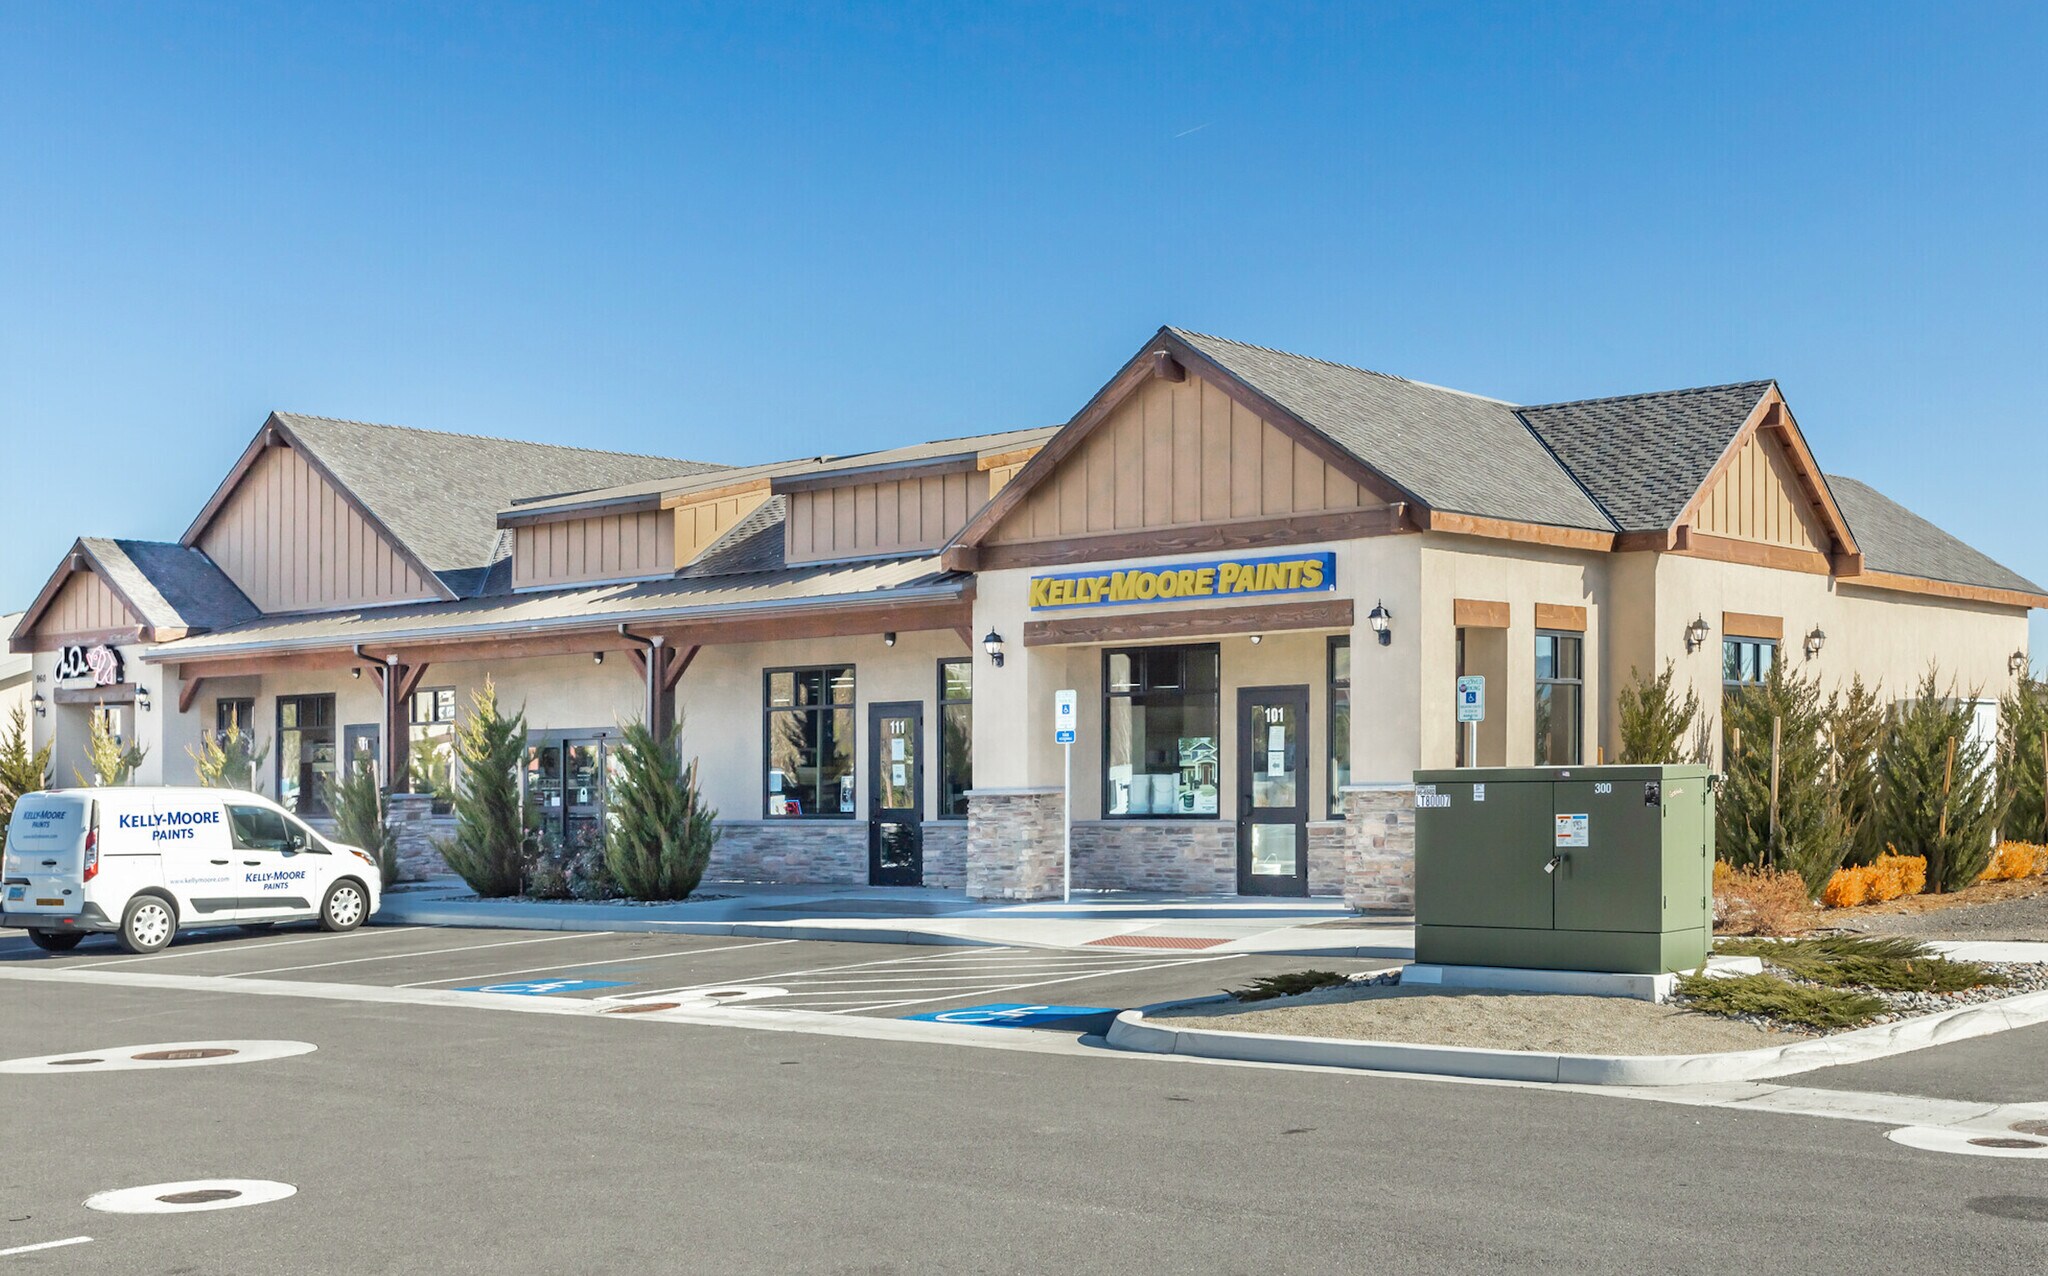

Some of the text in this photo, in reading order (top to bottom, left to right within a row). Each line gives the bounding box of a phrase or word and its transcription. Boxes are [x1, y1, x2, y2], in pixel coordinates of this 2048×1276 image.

[1029, 560, 1322, 606] KELLY-MOORE PAINTS
[1265, 707, 1284, 723] 101
[890, 720, 905, 734] 111
[1594, 783, 1612, 794] 300
[119, 811, 220, 828] KELLY-MOORE
[152, 828, 194, 841] PAINTS
[245, 870, 306, 883] KELLY-MOORE
[263, 882, 289, 890] PAINTS
